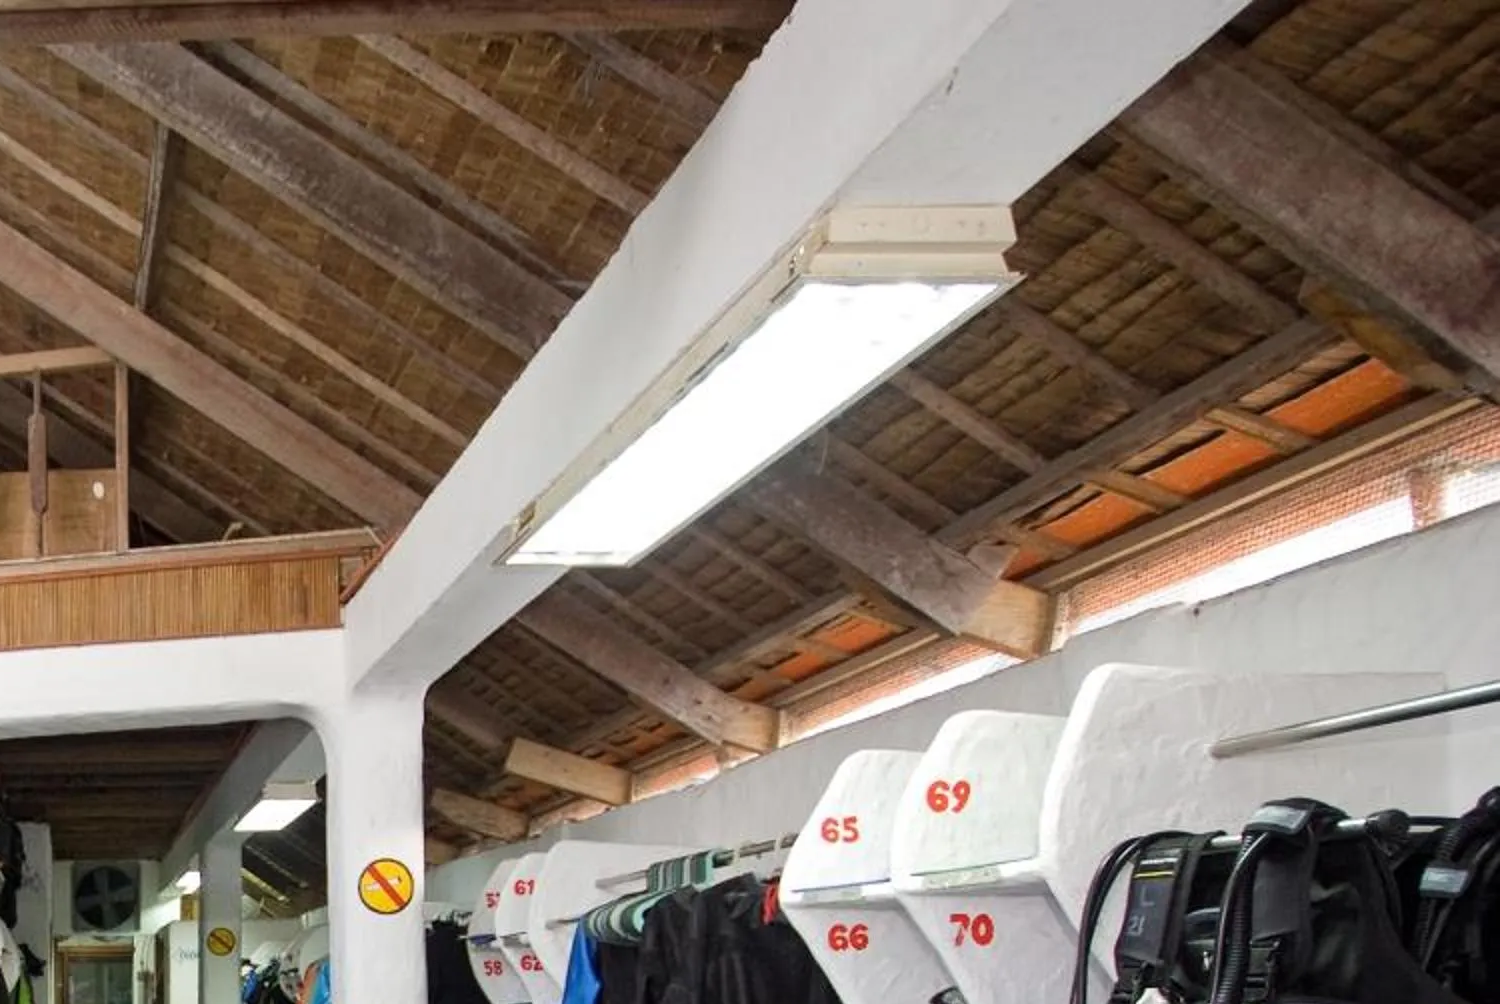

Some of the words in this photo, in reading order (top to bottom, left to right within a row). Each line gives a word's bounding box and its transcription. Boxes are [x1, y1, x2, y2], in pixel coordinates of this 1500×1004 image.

[925, 780, 971, 814] 69
[820, 816, 860, 844] 65
[513, 879, 536, 897] 61
[827, 922, 869, 952] 66
[948, 912, 995, 948] 70
[483, 959, 503, 977] 58
[520, 954, 544, 972] 62
